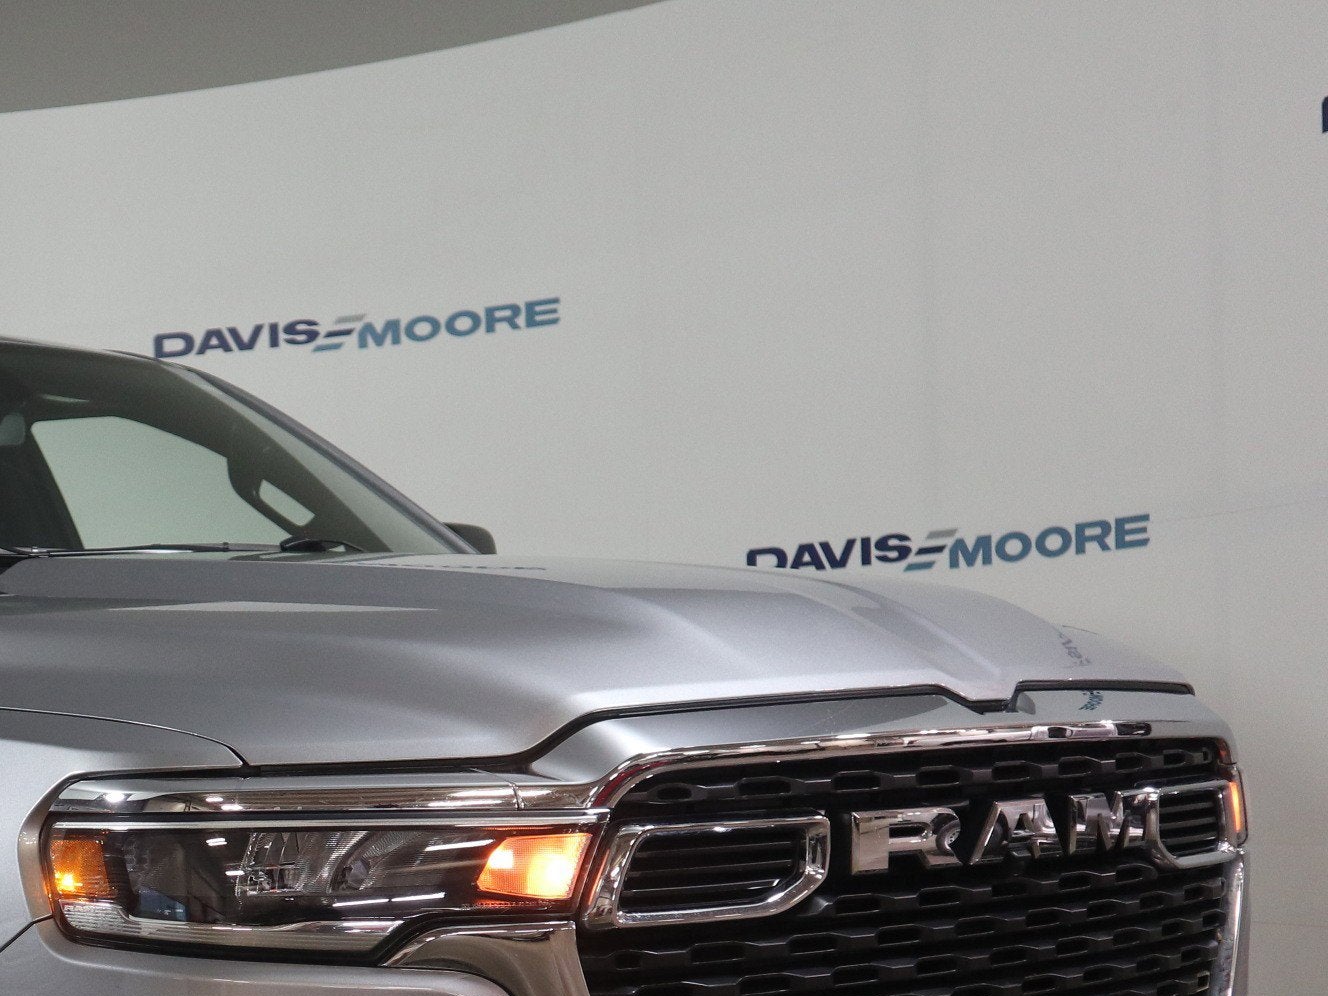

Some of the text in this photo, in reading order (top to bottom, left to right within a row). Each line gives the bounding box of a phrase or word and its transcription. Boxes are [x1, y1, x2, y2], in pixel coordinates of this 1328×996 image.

[153, 297, 560, 360] DAVIS MOORE
[746, 513, 1150, 571] DAVIS MOORE
[851, 790, 1152, 875] RAM
